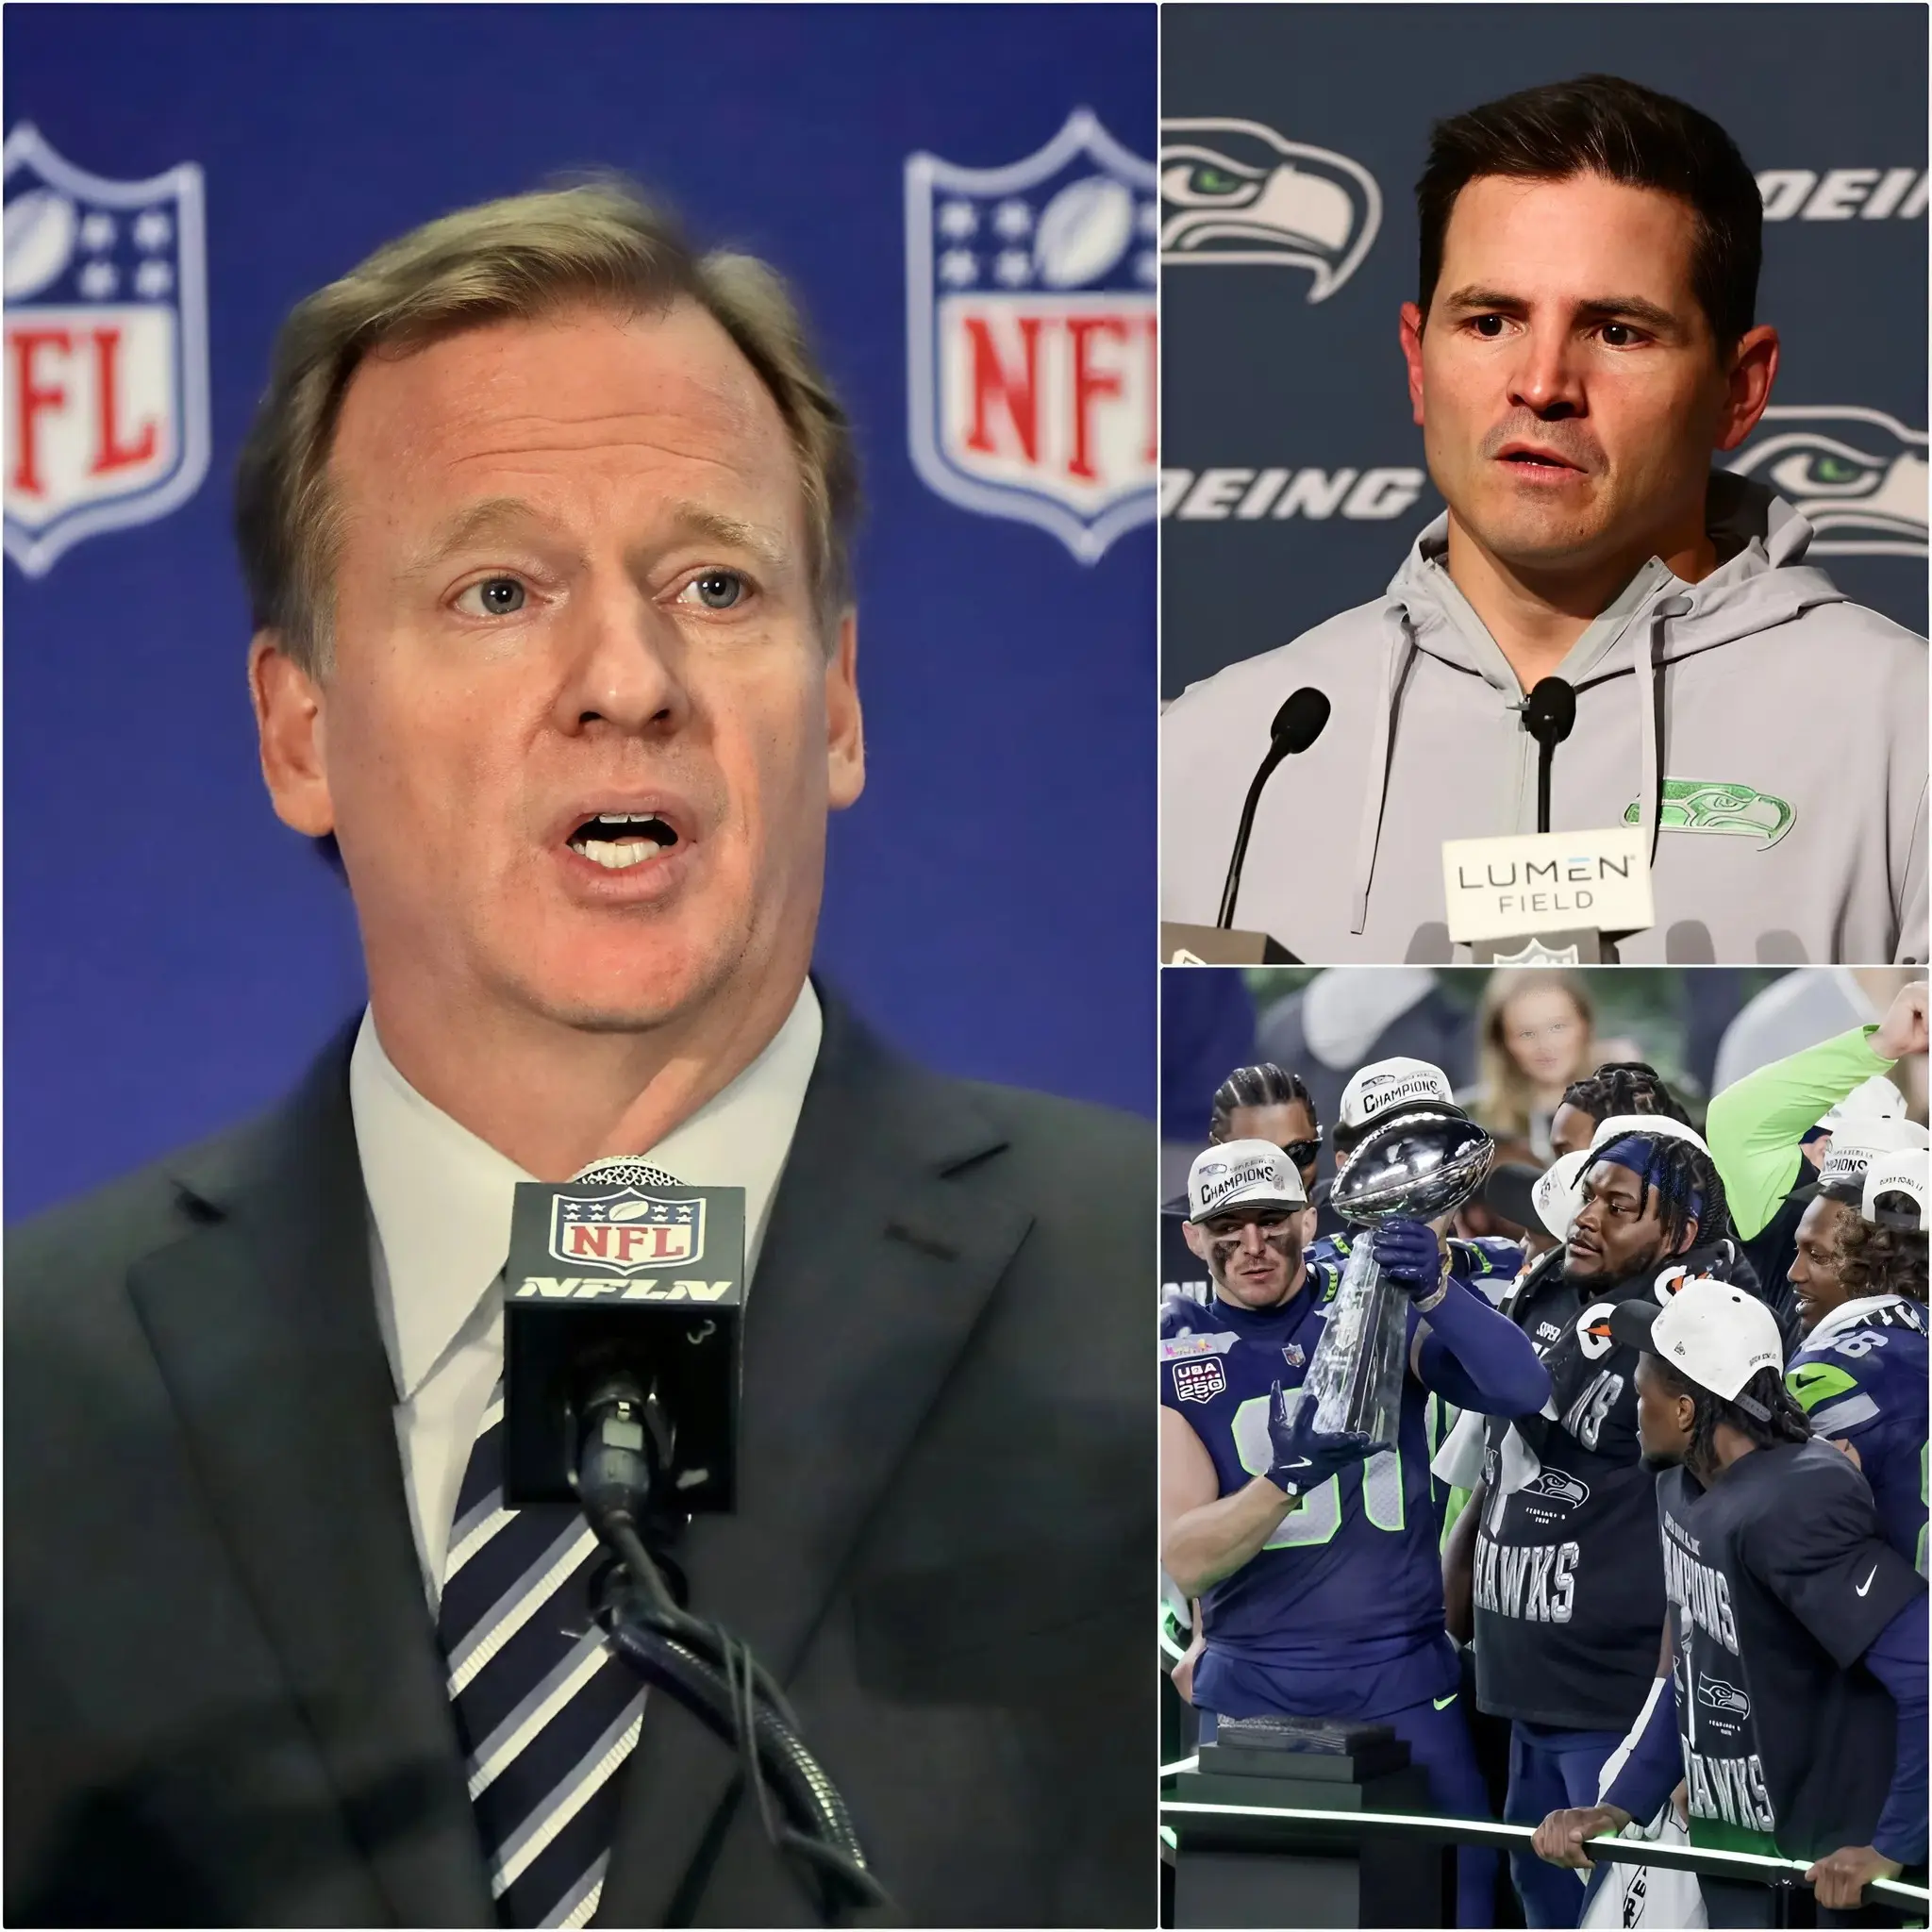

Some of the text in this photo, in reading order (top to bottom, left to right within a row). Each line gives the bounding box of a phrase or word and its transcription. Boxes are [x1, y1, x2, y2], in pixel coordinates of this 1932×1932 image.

[1754, 168, 1928, 221] OEI
[963, 316, 1158, 479] NF
[1458, 855, 1629, 889] LUMEN
[1499, 891, 1593, 913] FIELD
[1362, 1080, 1438, 1114] CHAMPIONS
[1201, 1166, 1274, 1205] CHAMPIONS
[570, 1225, 685, 1261] NFL
[1179, 1378, 1224, 1398] 250
